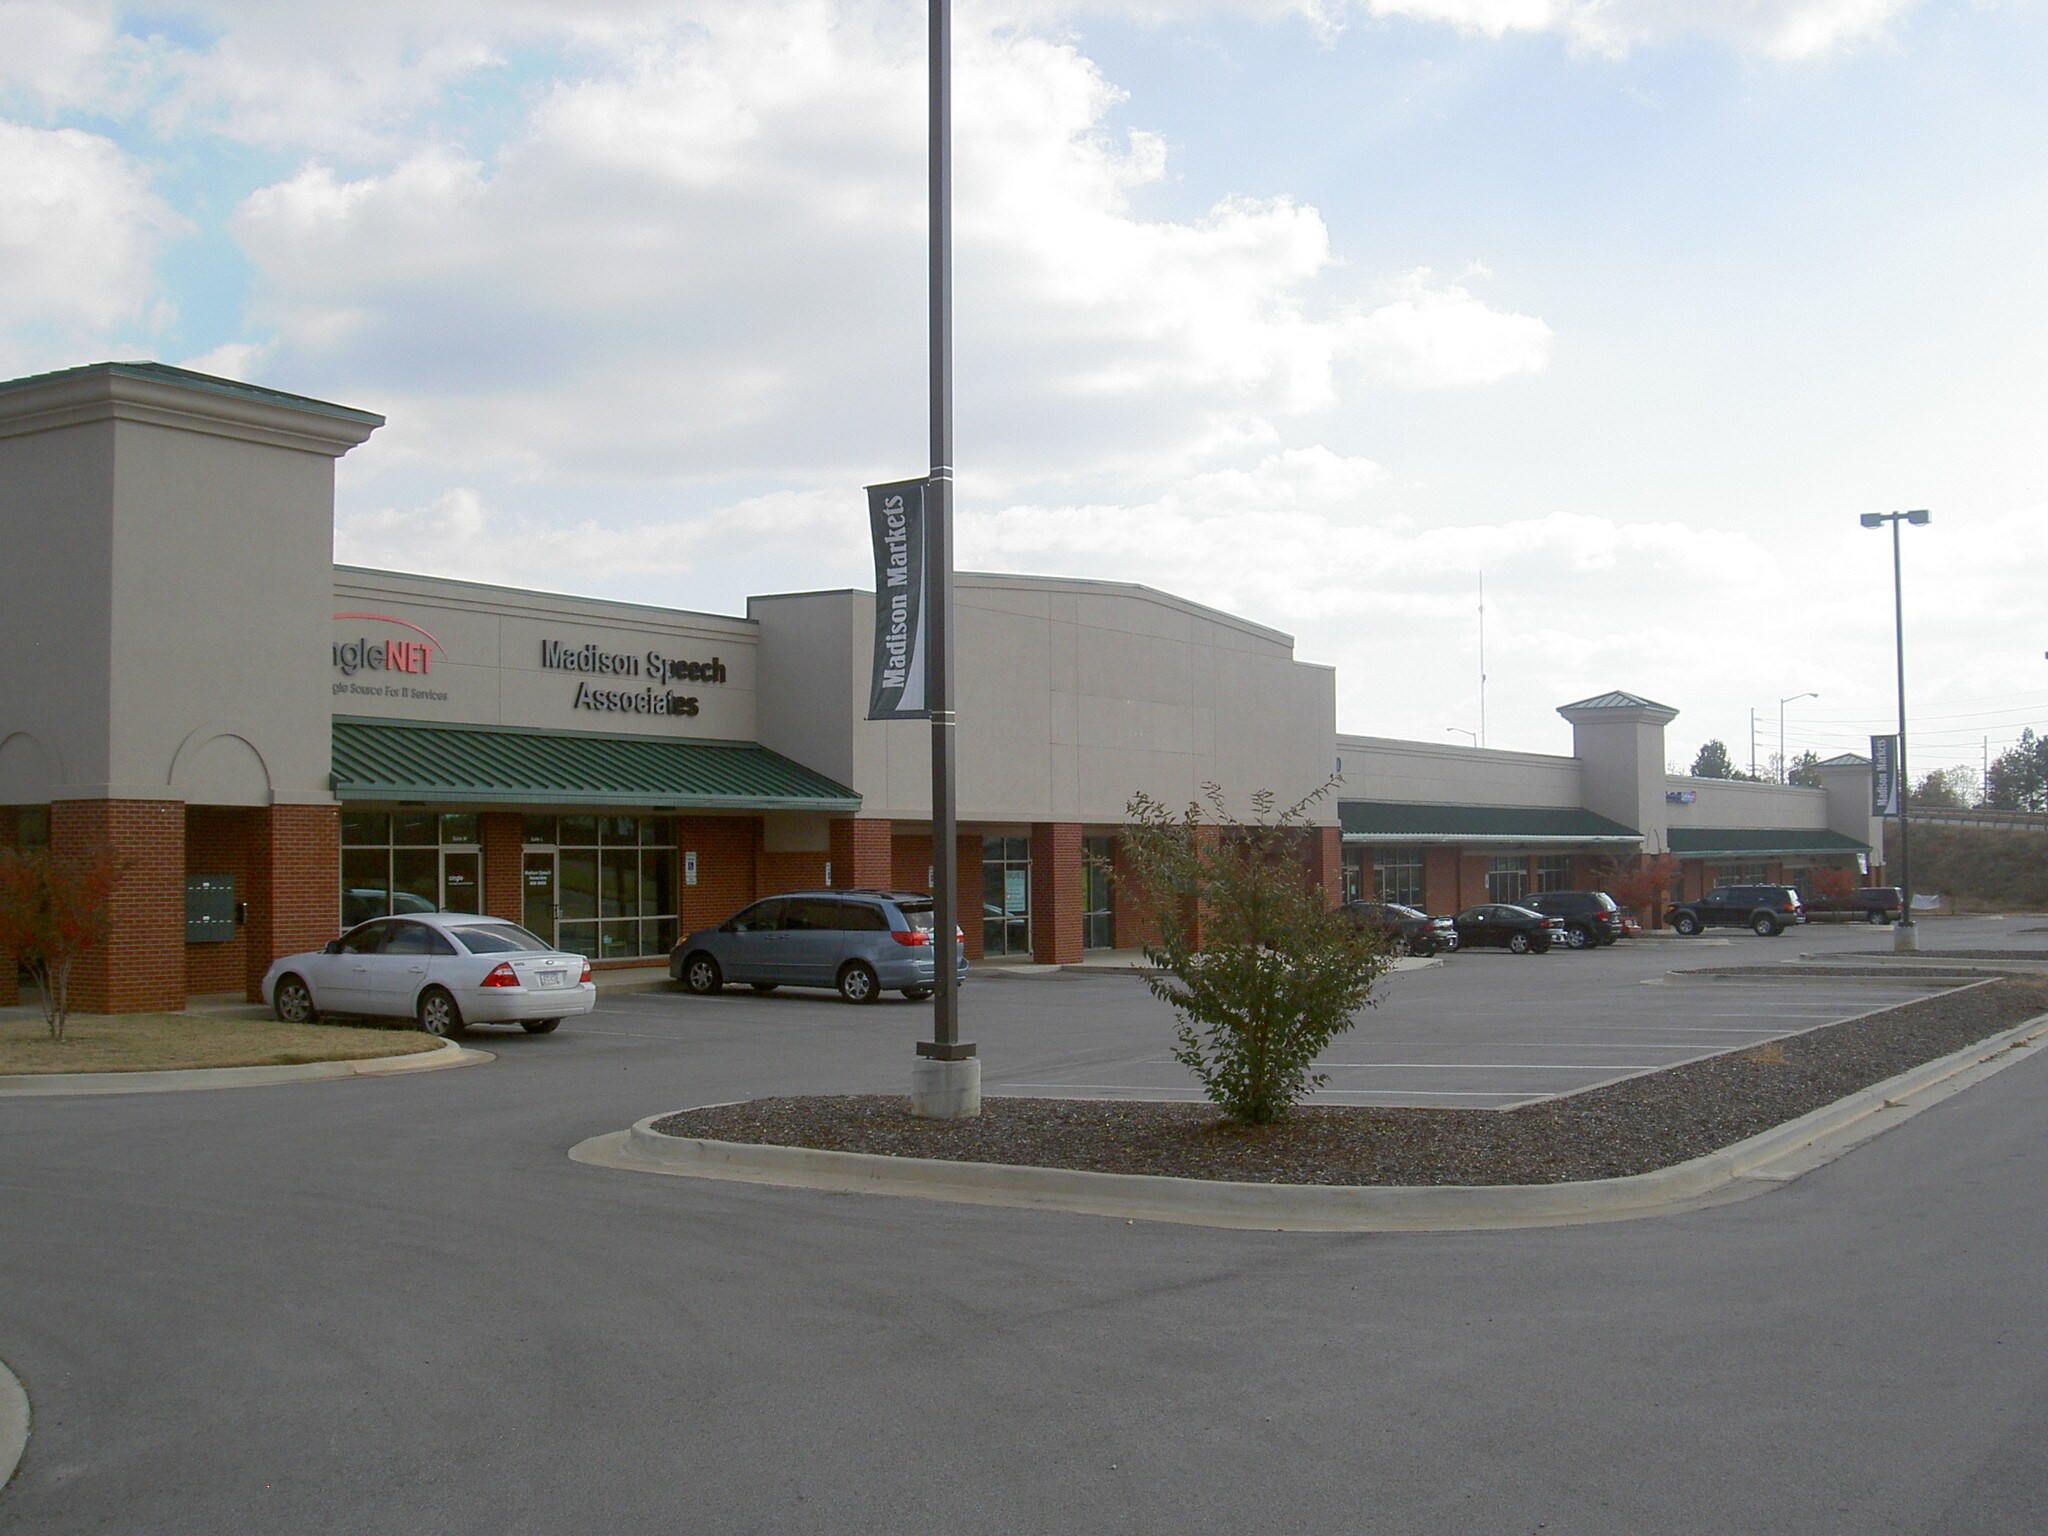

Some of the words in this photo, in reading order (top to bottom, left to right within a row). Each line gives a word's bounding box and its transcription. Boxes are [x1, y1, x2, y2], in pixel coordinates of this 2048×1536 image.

[884, 494, 908, 588] Markets
[541, 639, 640, 676] Madison
[646, 650, 727, 685] Speech
[882, 593, 908, 689] Madison
[350, 683, 382, 697] Source
[385, 685, 399, 698] For
[411, 688, 448, 701] Services
[573, 681, 700, 717] Associates
